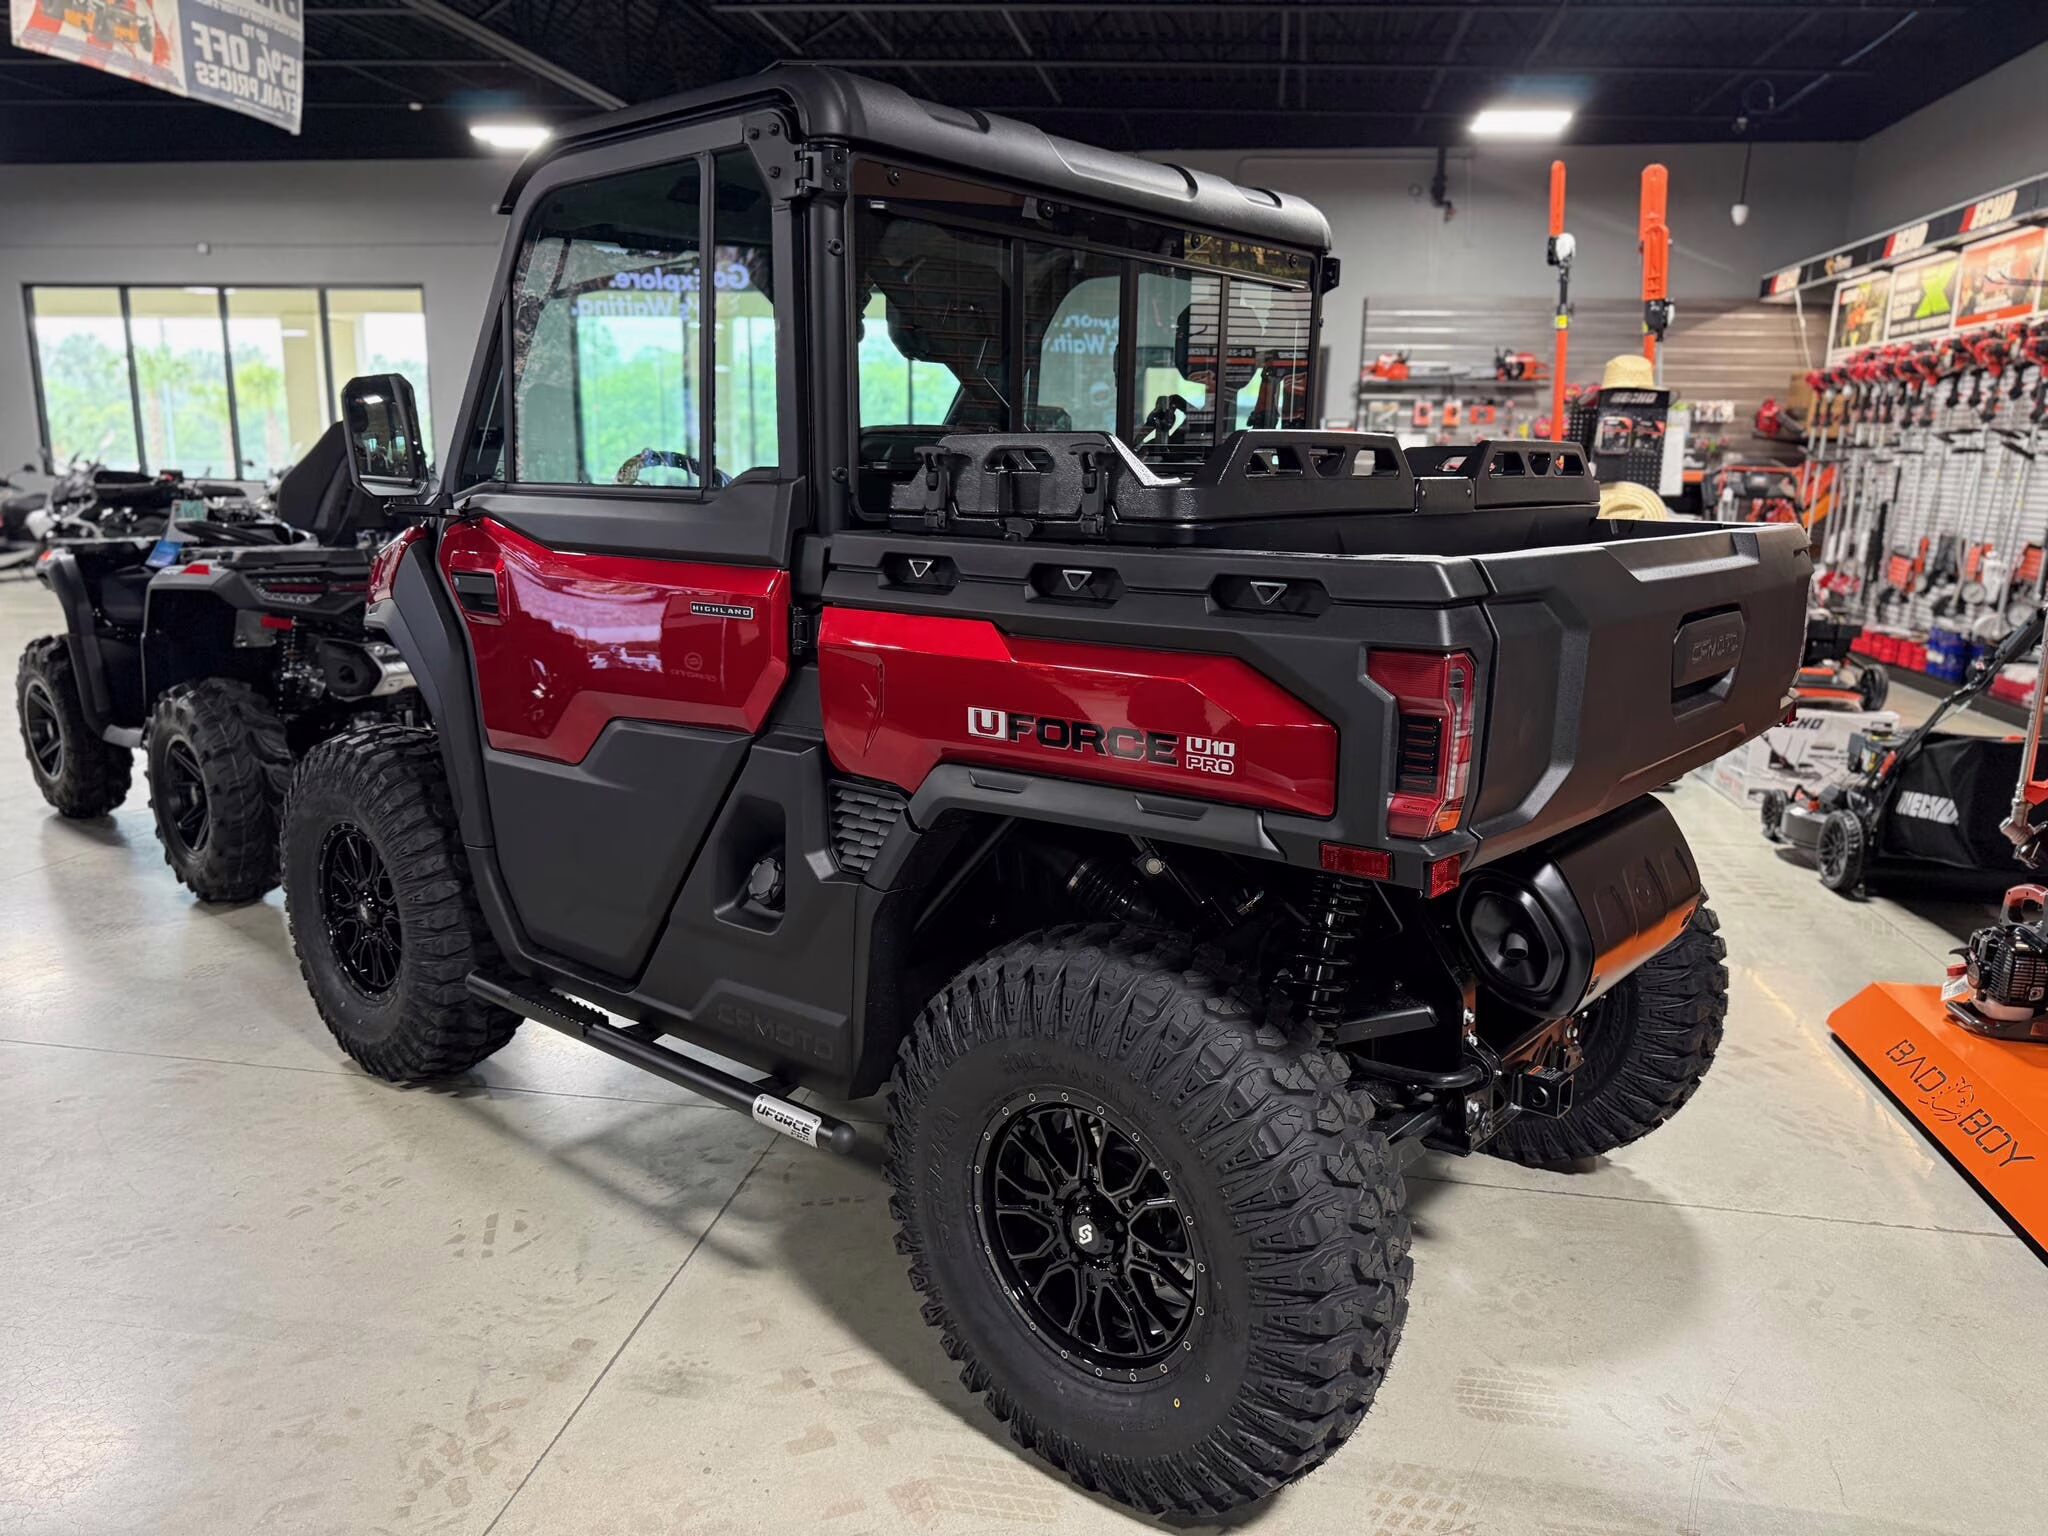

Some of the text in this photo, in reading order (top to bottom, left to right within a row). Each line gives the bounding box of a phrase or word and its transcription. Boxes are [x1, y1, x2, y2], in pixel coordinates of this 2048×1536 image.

[692, 604, 751, 616] HIGHLAND
[1185, 754, 1235, 776] PRO
[1902, 791, 1959, 825] ECHO
[1885, 1039, 2036, 1168] BAD BOY
